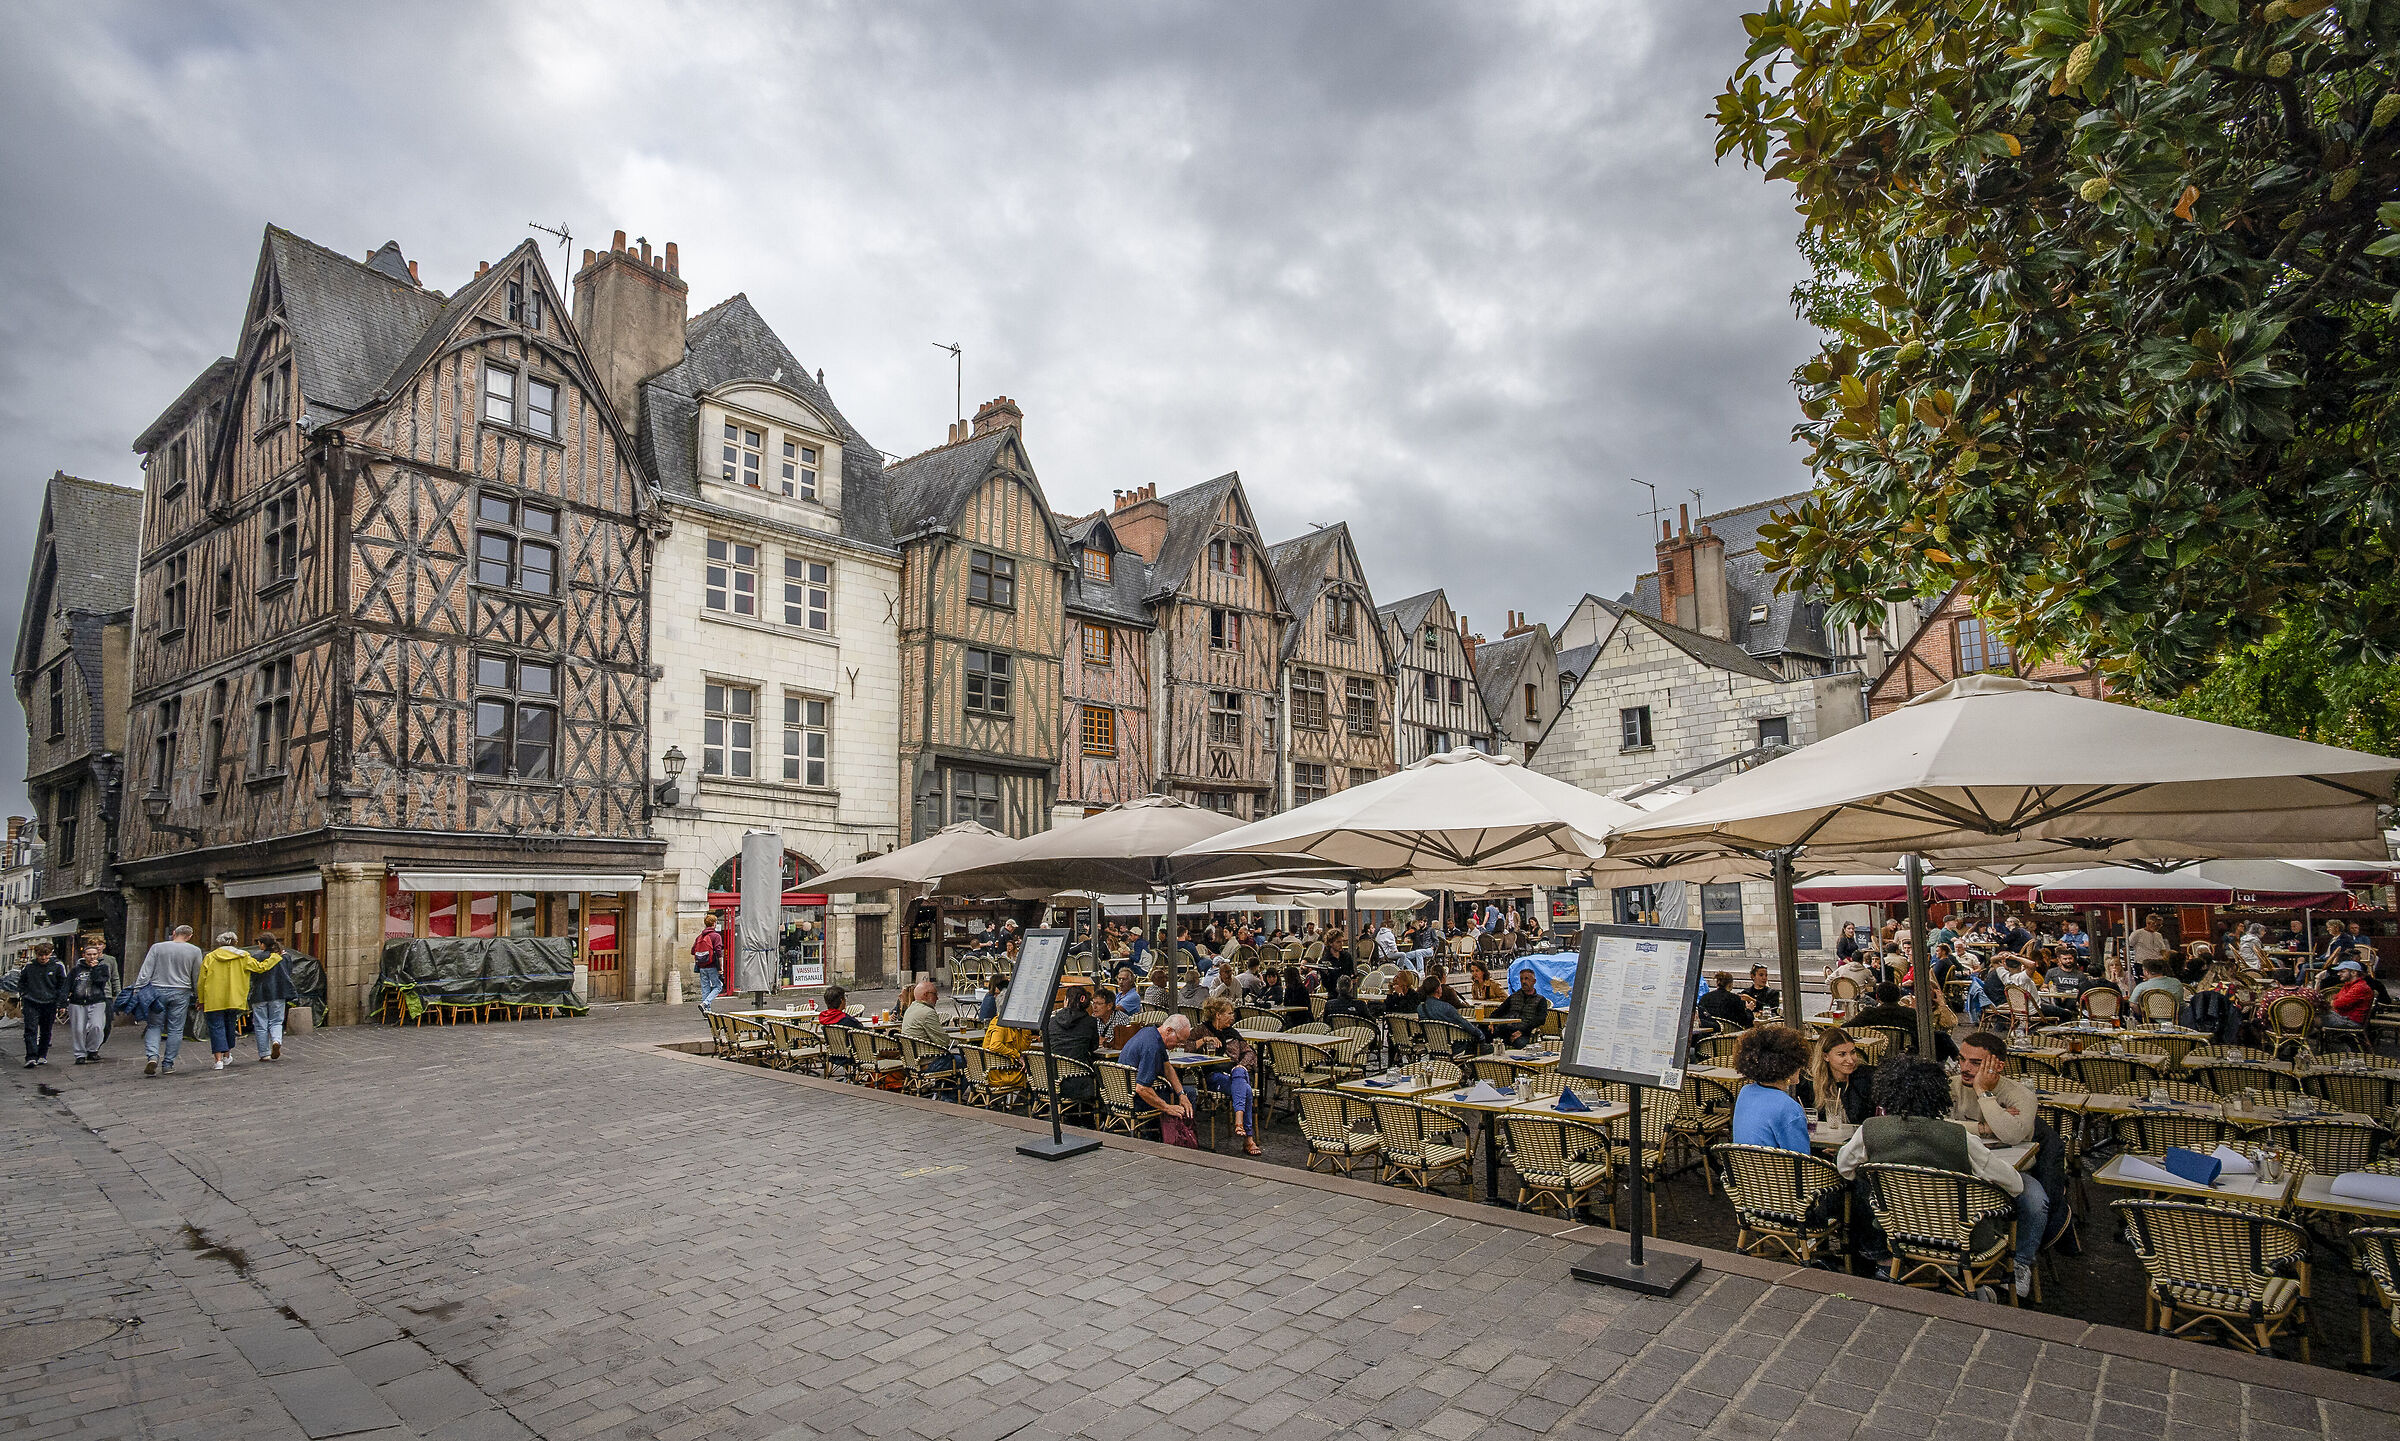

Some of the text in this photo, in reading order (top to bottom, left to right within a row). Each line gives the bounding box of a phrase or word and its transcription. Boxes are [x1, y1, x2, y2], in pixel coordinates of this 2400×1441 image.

[796, 966, 820, 974] VAISSELLE
[794, 974, 823, 982] ARTISANALE
[2058, 976, 2079, 985] VANS
